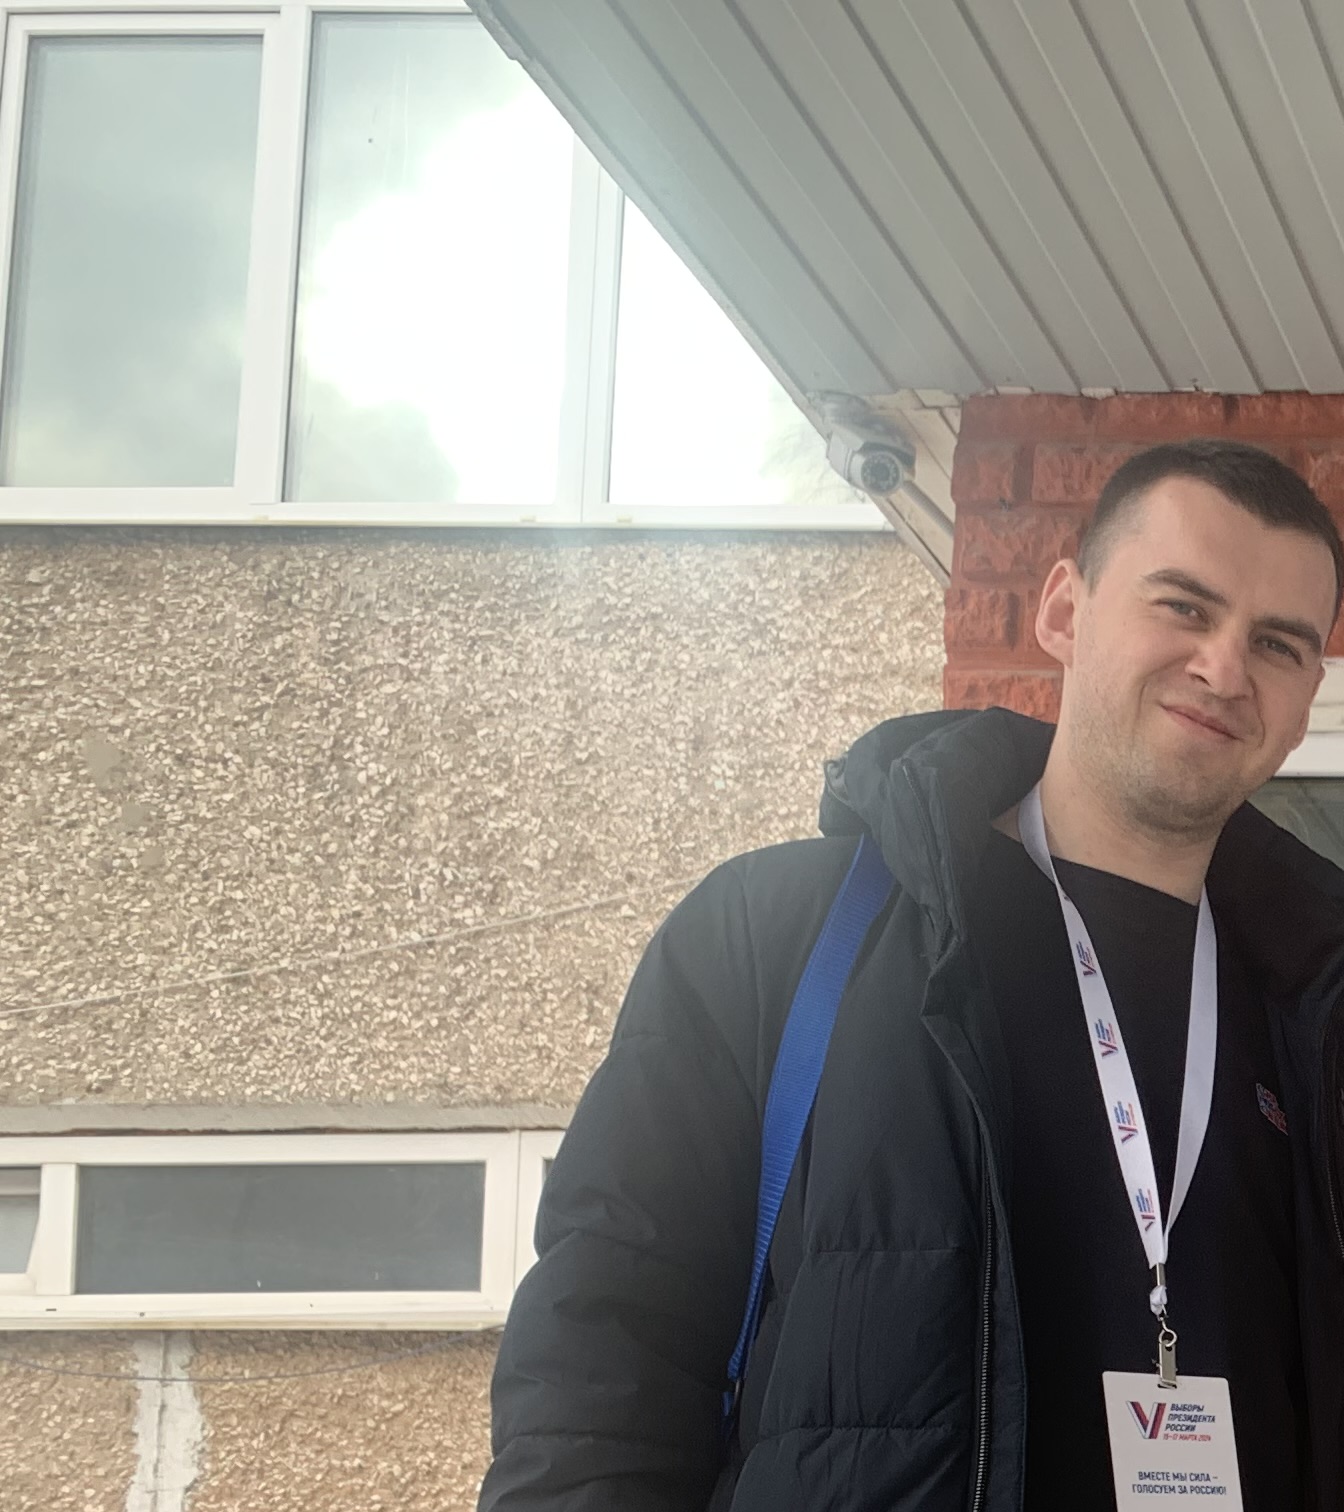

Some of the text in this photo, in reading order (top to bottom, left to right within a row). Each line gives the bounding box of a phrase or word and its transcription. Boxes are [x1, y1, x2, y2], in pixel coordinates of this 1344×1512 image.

[1170, 1403, 1204, 1412] ВЫБОРЫ
[1168, 1414, 1216, 1423] ПРЕЗИДЕНТА
[1138, 1471, 1170, 1481] ВМЕСТЕ
[1172, 1472, 1187, 1482] МЫ
[1189, 1473, 1211, 1482] СИЛА
[1132, 1484, 1226, 1495] ГОЛОСУЕМ ЗА РОССИЮ!
